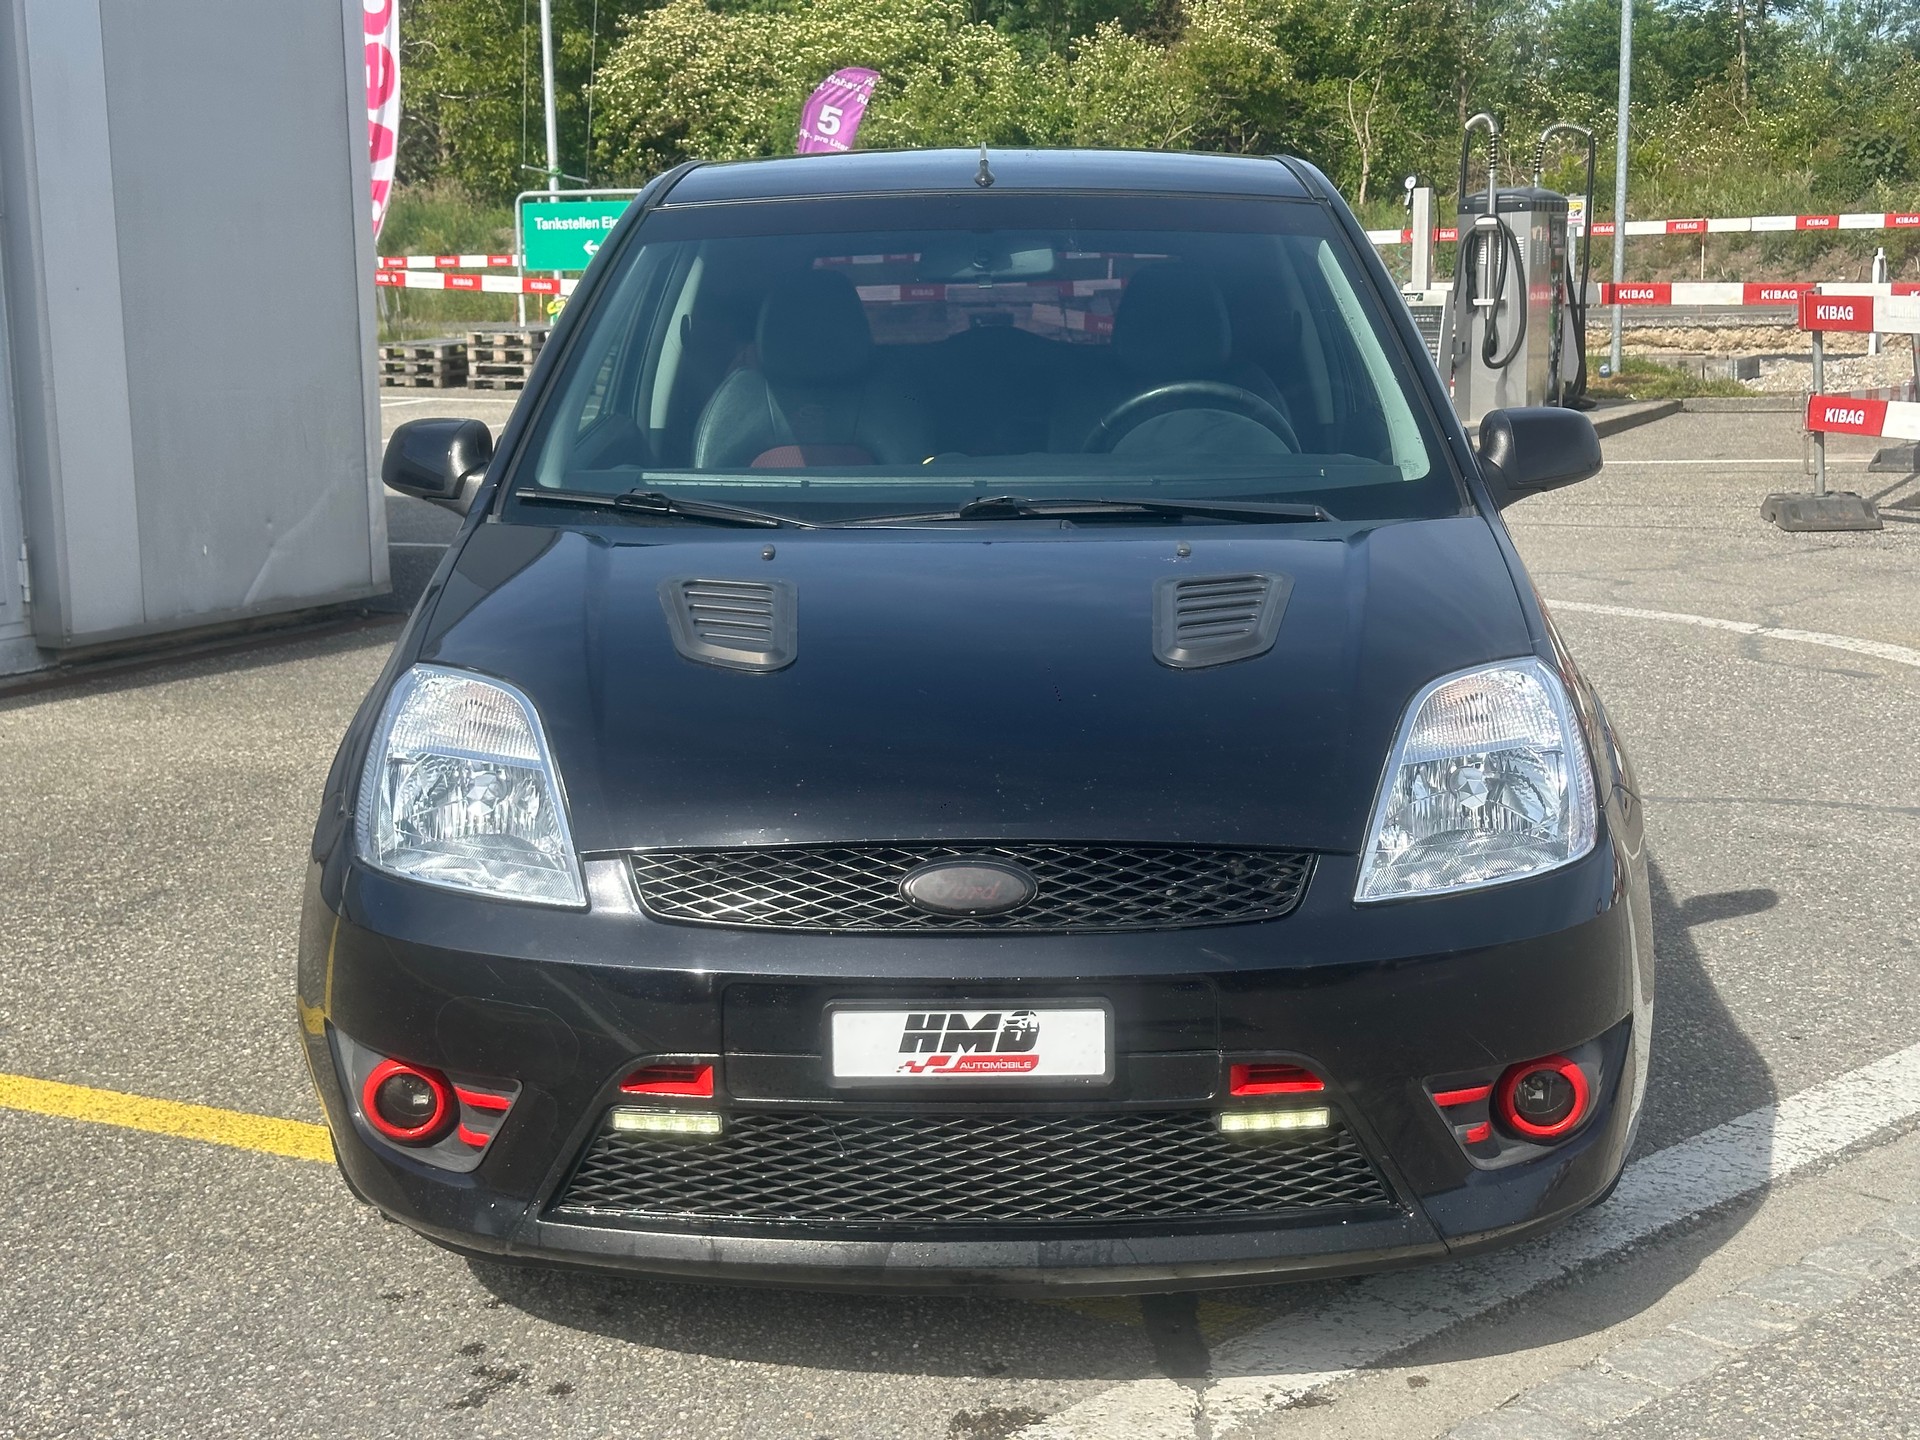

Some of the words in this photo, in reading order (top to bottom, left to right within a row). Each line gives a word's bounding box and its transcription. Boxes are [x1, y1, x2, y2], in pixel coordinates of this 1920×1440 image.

[817, 104, 843, 135] 5
[814, 135, 828, 144] pro
[830, 139, 849, 151] Liter
[534, 216, 599, 230] Tankstellen
[1806, 218, 1829, 226] KIBAG
[1895, 216, 1919, 224] KIBAG
[1618, 289, 1655, 299] KIBAG
[1760, 289, 1799, 300] KIBAG
[1816, 305, 1854, 320] KIBAG
[1824, 408, 1865, 424] KIBAG
[960, 1061, 1031, 1069] AUTOMOBILE
